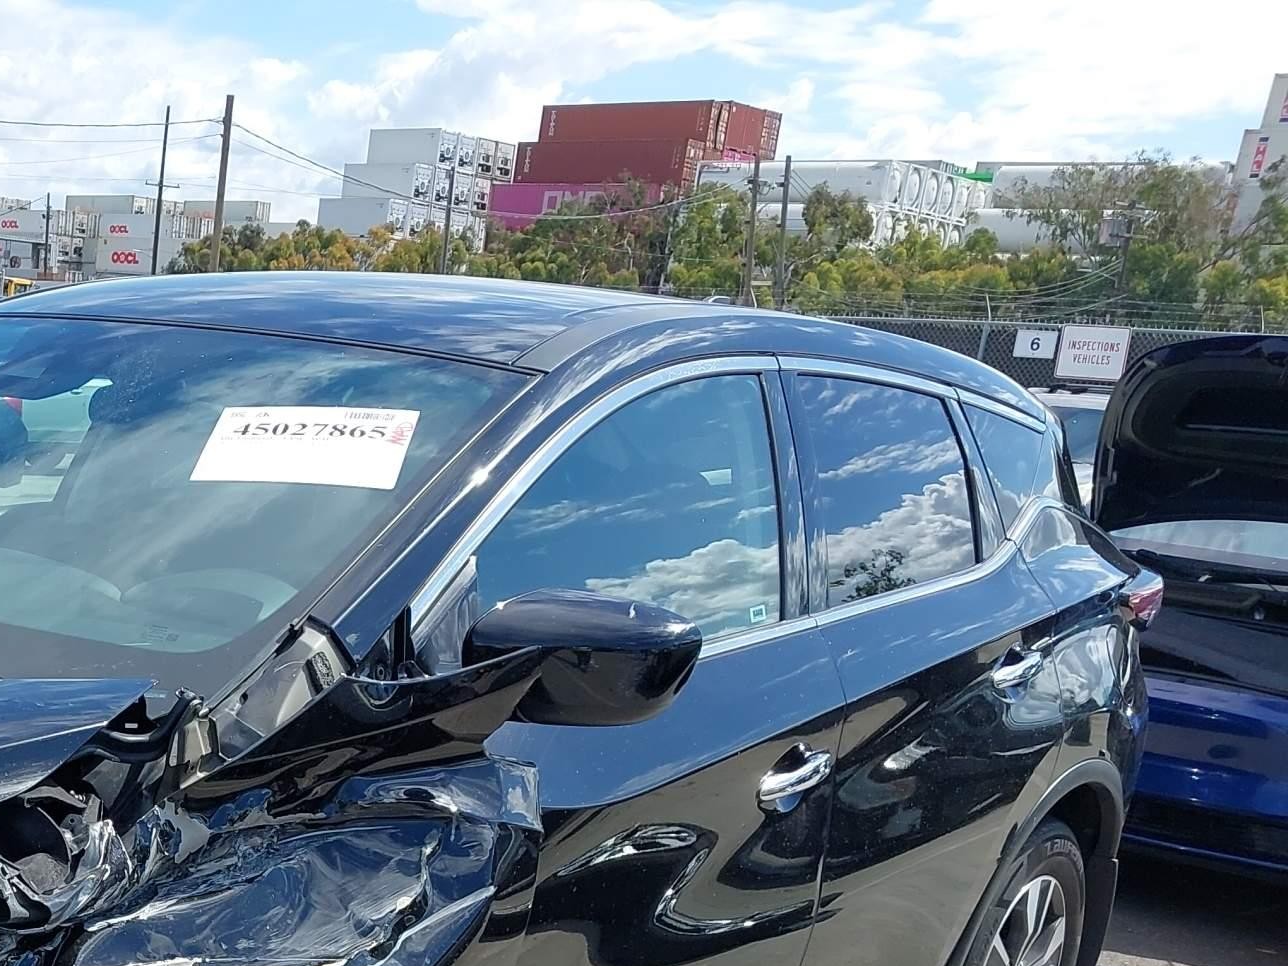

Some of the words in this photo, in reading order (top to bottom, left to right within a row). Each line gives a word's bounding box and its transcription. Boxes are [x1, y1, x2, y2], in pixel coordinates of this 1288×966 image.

[111, 251, 139, 265] OOCL
[1030, 337, 1041, 351] 6
[1067, 340, 1121, 353] INSPECTIONS
[1072, 354, 1111, 365] VEHICLES
[232, 422, 389, 440] 45027865
